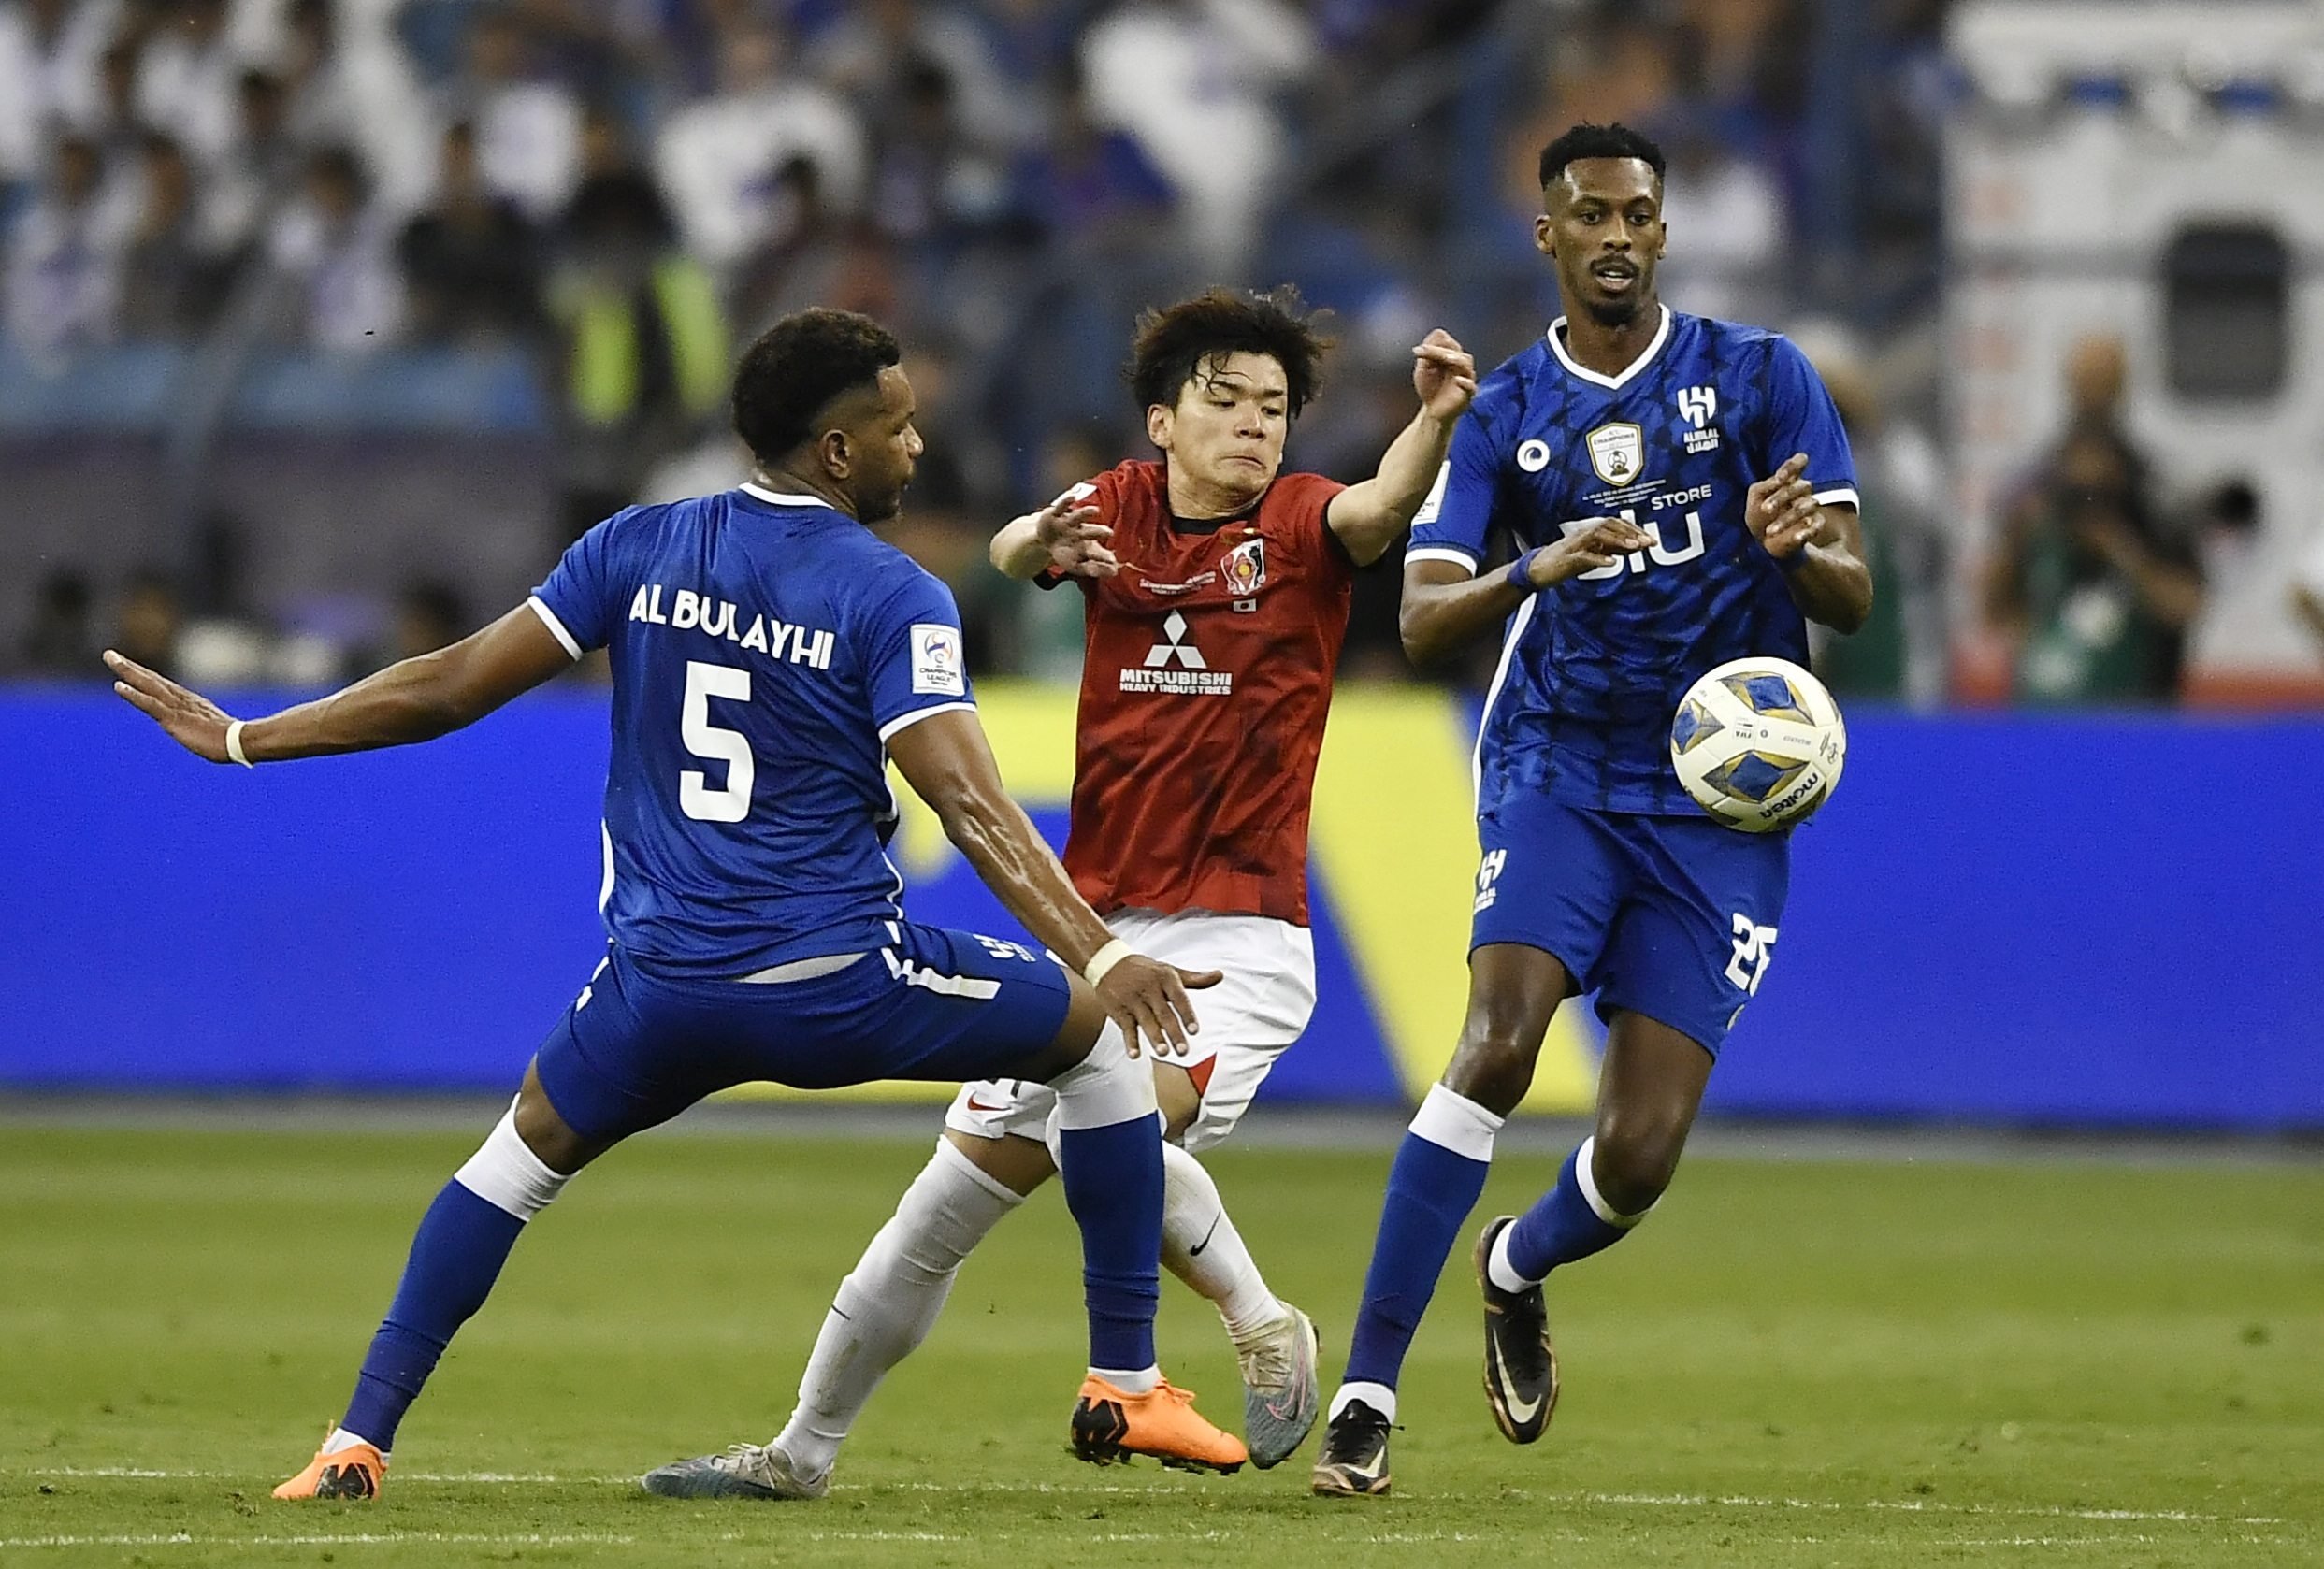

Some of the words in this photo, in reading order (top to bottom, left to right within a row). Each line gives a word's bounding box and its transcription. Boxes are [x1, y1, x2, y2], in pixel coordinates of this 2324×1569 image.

[1651, 484, 1712, 511] STORE
[629, 583, 667, 626] AL
[671, 589, 836, 670] BULAYHI
[1119, 669, 1233, 686] MITSUBISHI
[1119, 684, 1157, 693] HEAVY
[1159, 684, 1232, 696] INDUSTRIES
[679, 660, 755, 823] 5
[1759, 771, 1819, 819] molten
